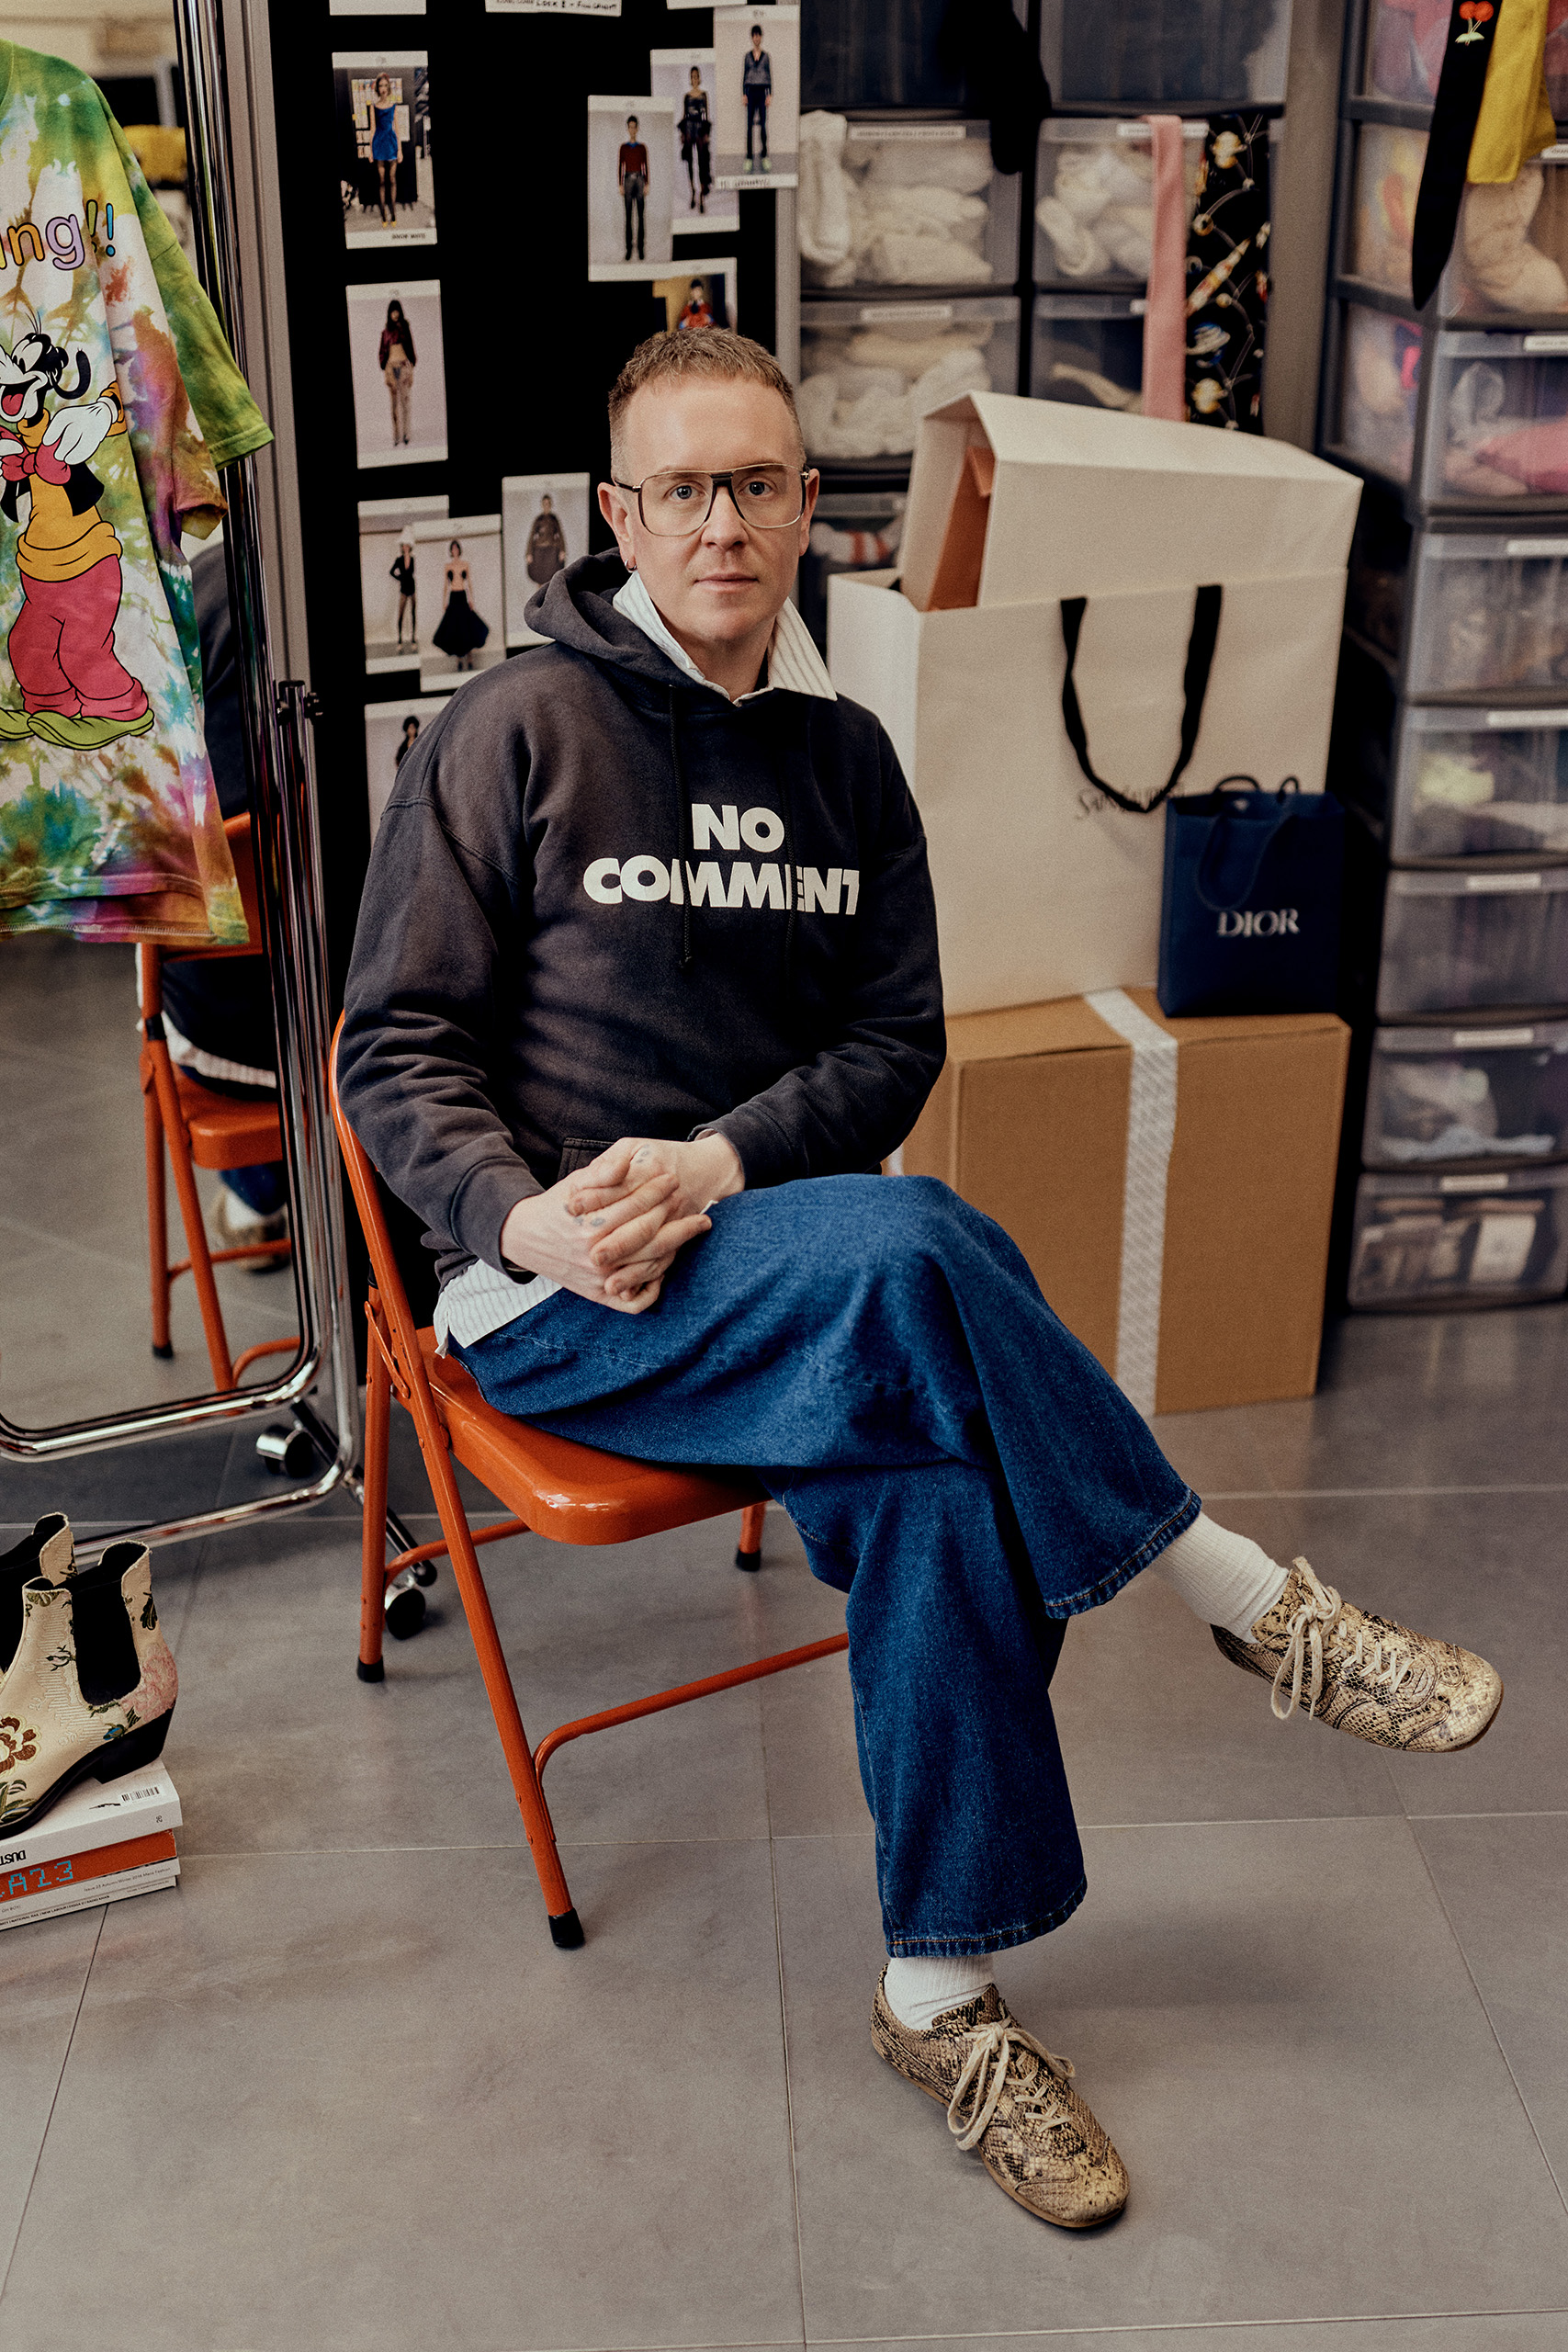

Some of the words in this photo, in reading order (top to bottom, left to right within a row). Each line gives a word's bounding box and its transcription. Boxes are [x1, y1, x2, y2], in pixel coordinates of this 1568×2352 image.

[691, 803, 785, 853] NO
[582, 854, 860, 915] COMMENT
[1217, 908, 1300, 937] DIOR
[0, 1849, 27, 1866] DUST
